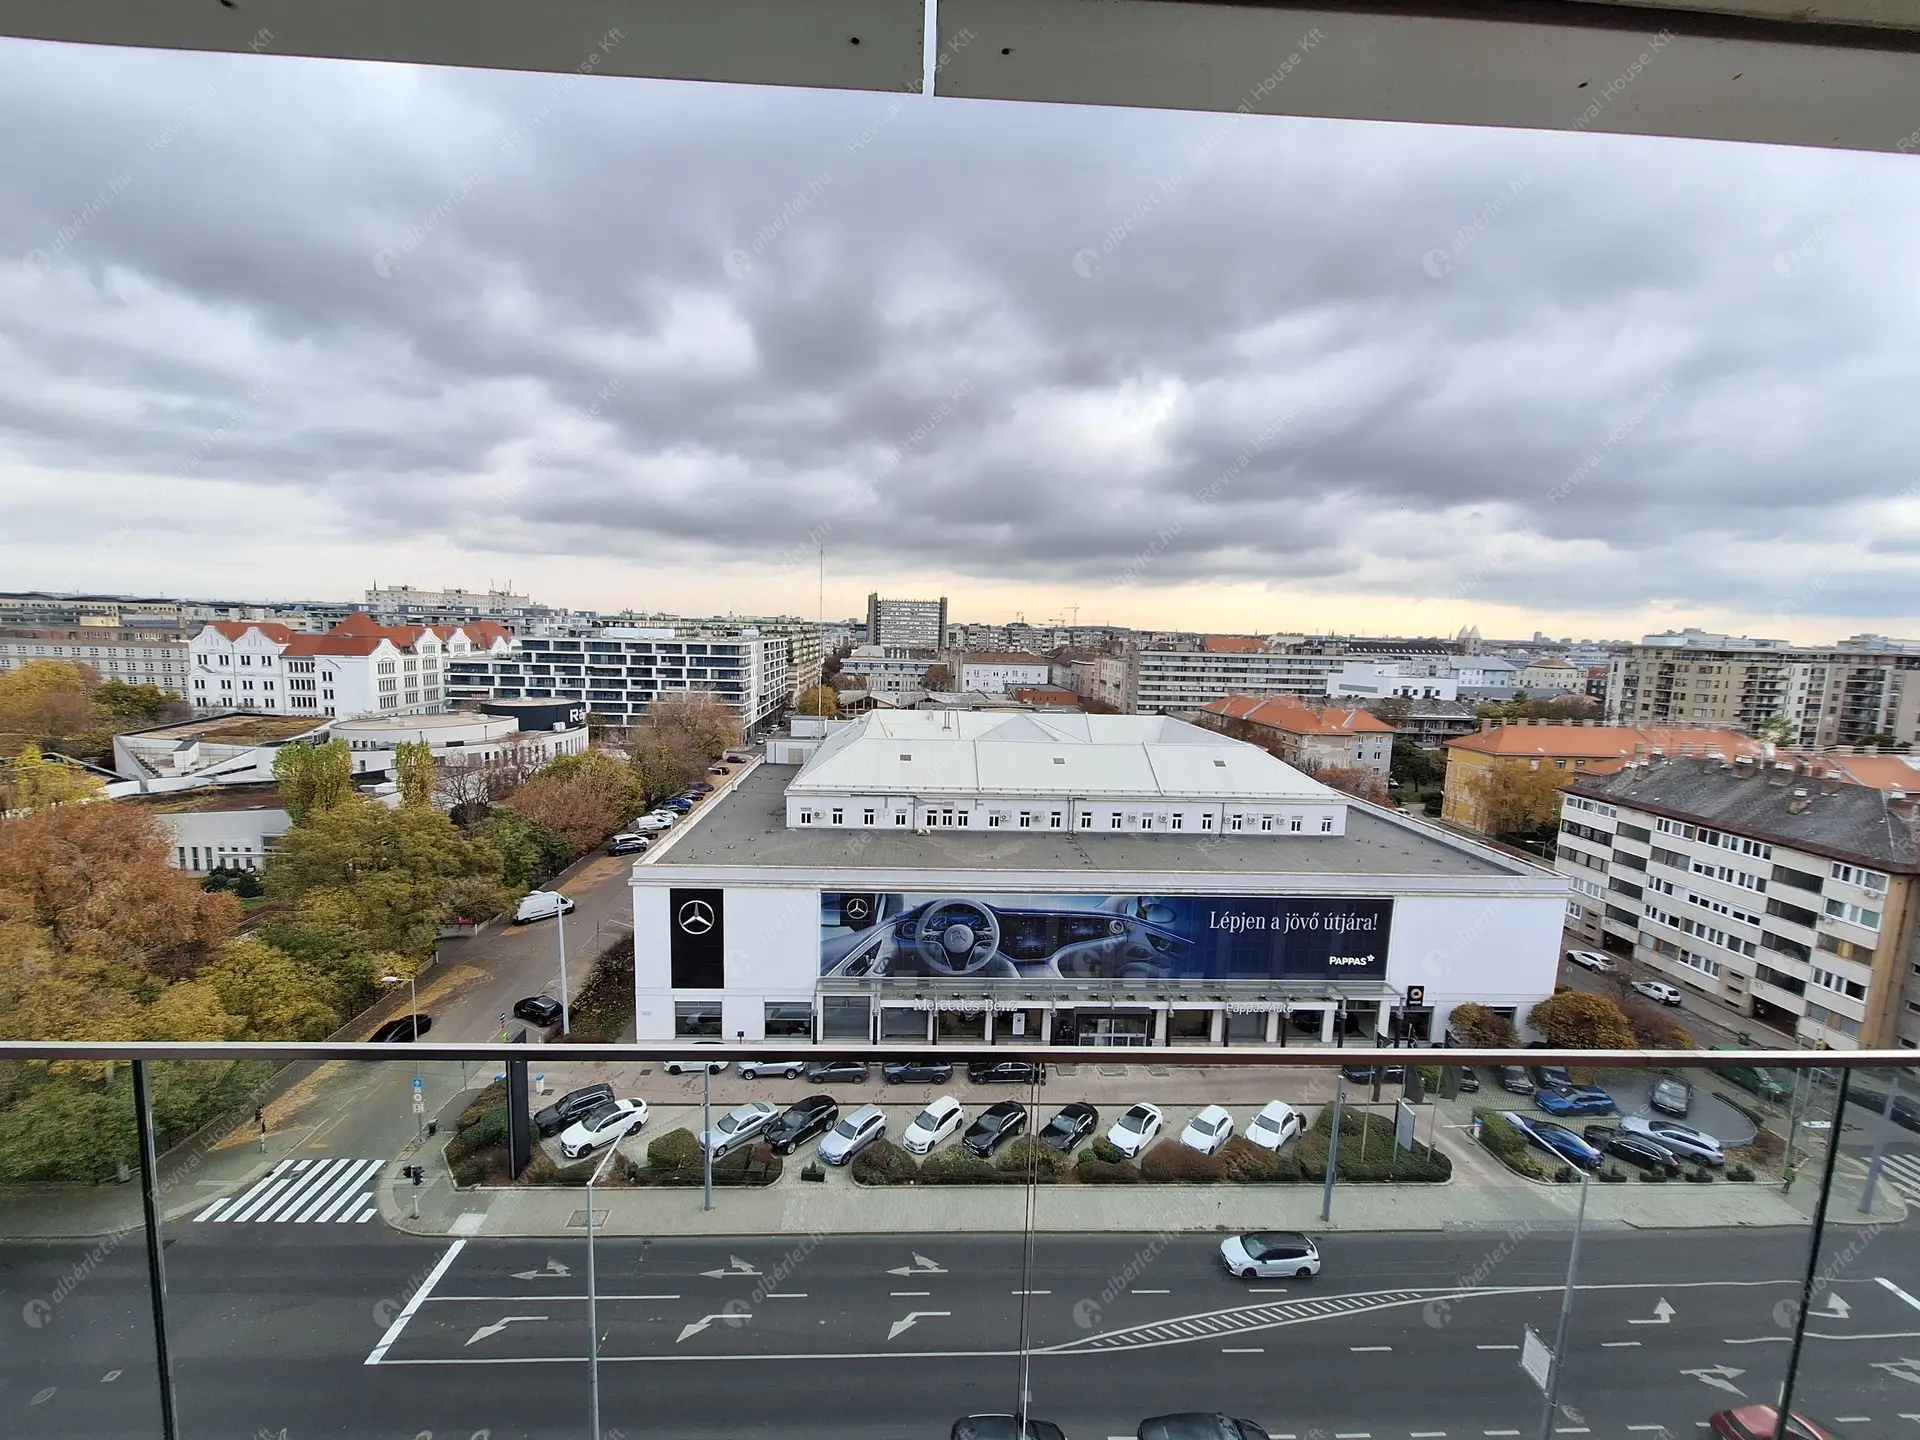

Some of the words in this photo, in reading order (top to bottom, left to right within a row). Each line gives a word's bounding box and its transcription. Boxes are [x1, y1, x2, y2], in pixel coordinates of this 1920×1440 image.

[1209, 911, 1266, 933] Lépjen
[1270, 917, 1280, 930] a
[1283, 912, 1319, 934] jövő
[1324, 912, 1378, 934] útjára!
[1329, 956, 1367, 966] PAPPAS
[913, 998, 1018, 1011] Mercedes-Benz
[1226, 1002, 1265, 1015] Pappas
